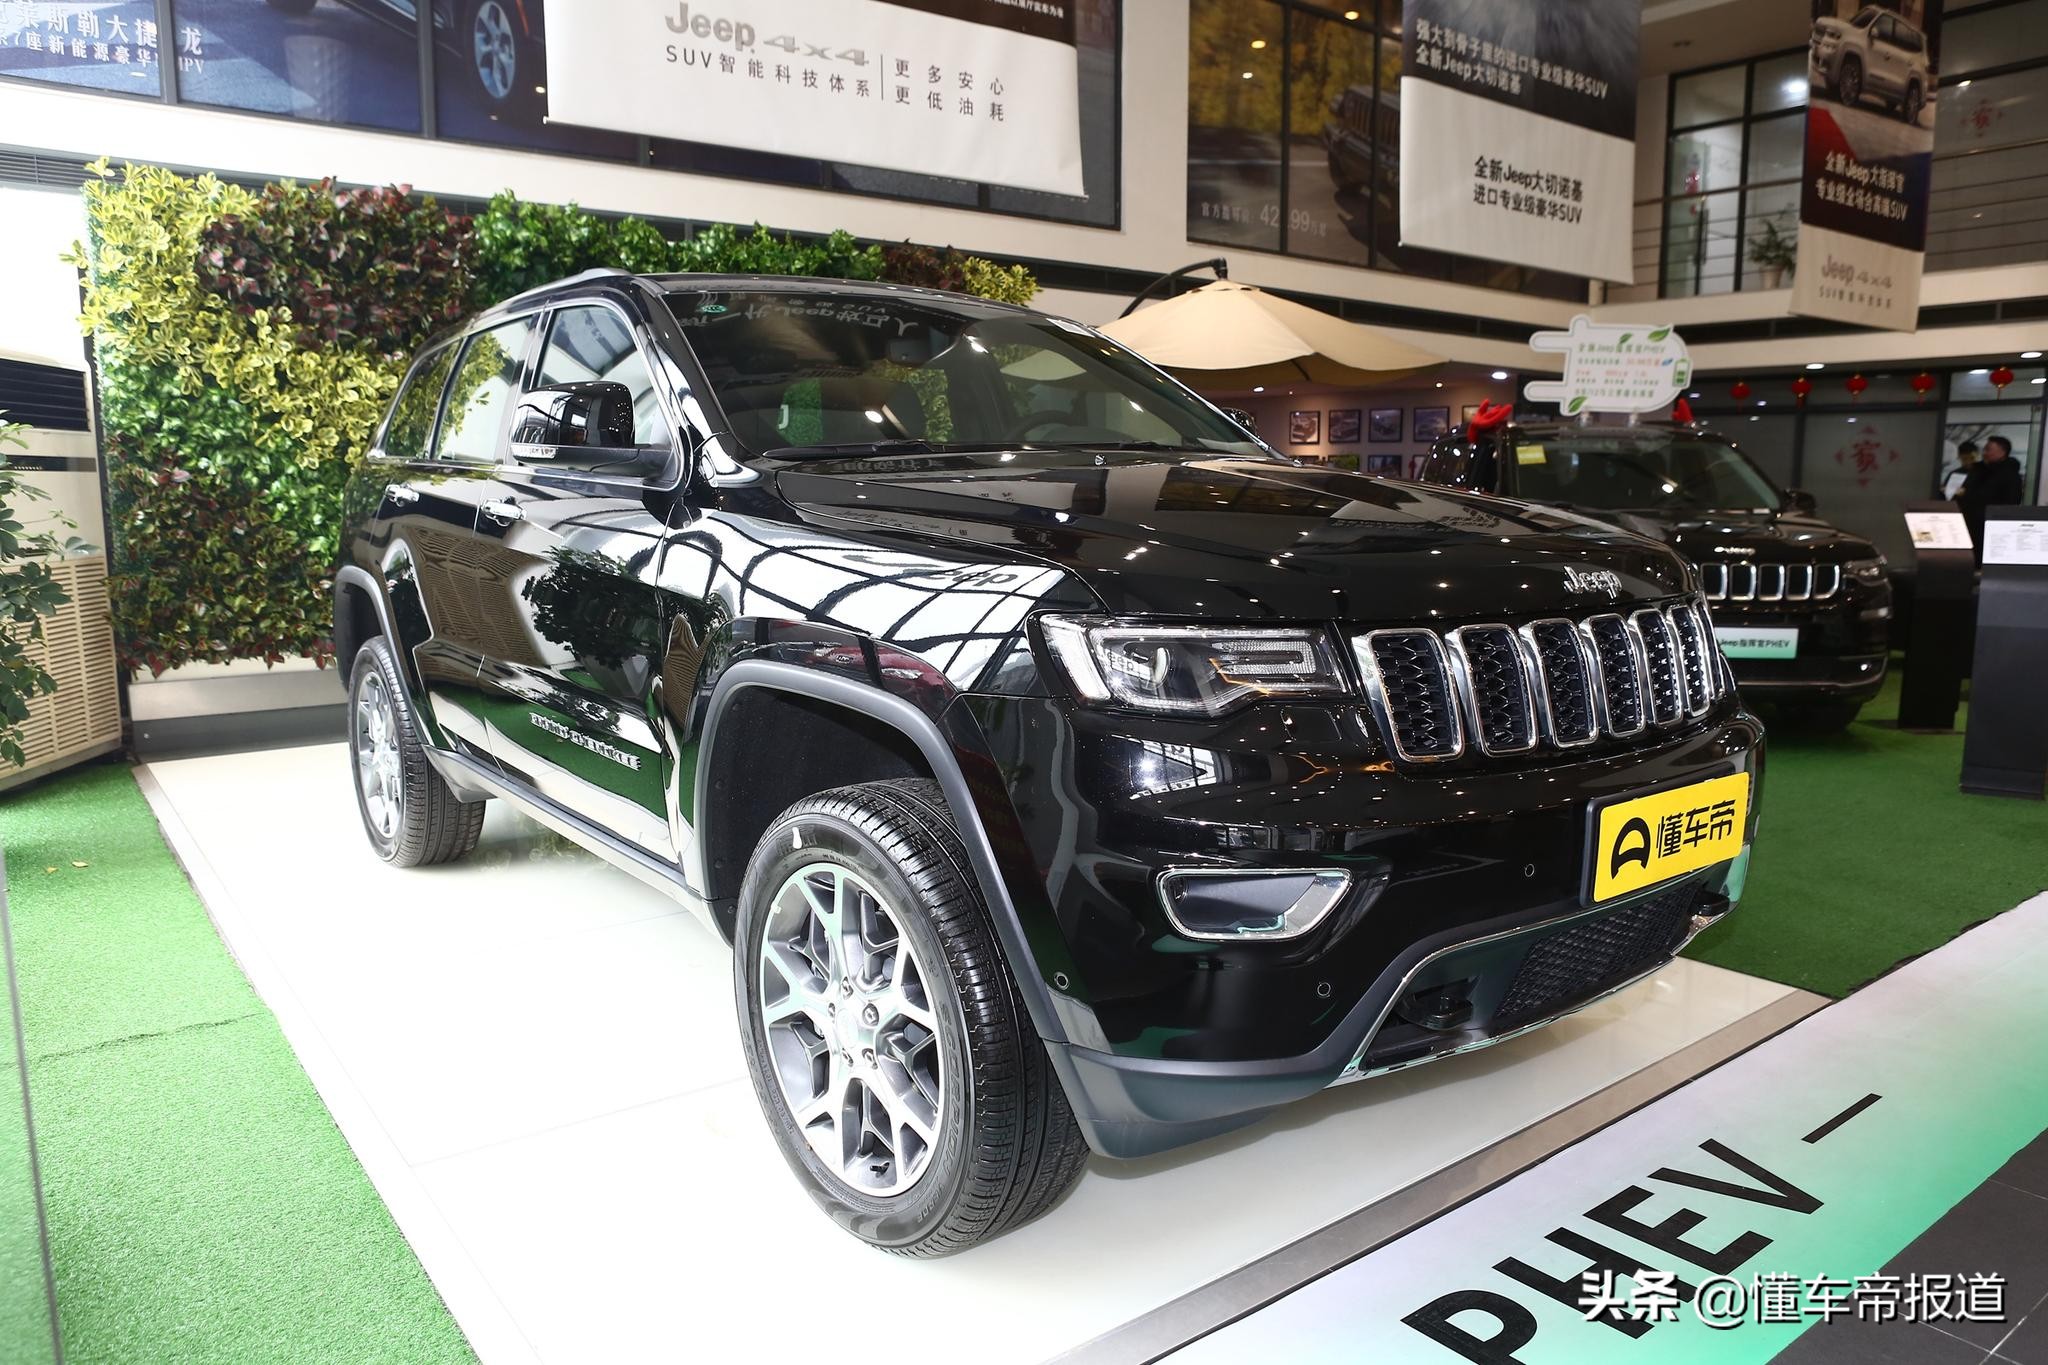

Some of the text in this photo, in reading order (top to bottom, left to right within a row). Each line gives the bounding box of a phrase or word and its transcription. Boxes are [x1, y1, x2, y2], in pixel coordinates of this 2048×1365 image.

[664, 1, 756, 54] Jeep
[894, 58, 1004, 96] 更多安心
[894, 85, 1005, 122] 更低油耗
[1474, 155, 1583, 203] 全新Jeep大切诺基
[1473, 183, 1583, 224] 进口专业级豪华SUV
[1563, 565, 1622, 599] Jeep
[1655, 799, 1737, 859] 懂车帝
[1400, 1138, 1825, 1365] PHEV
